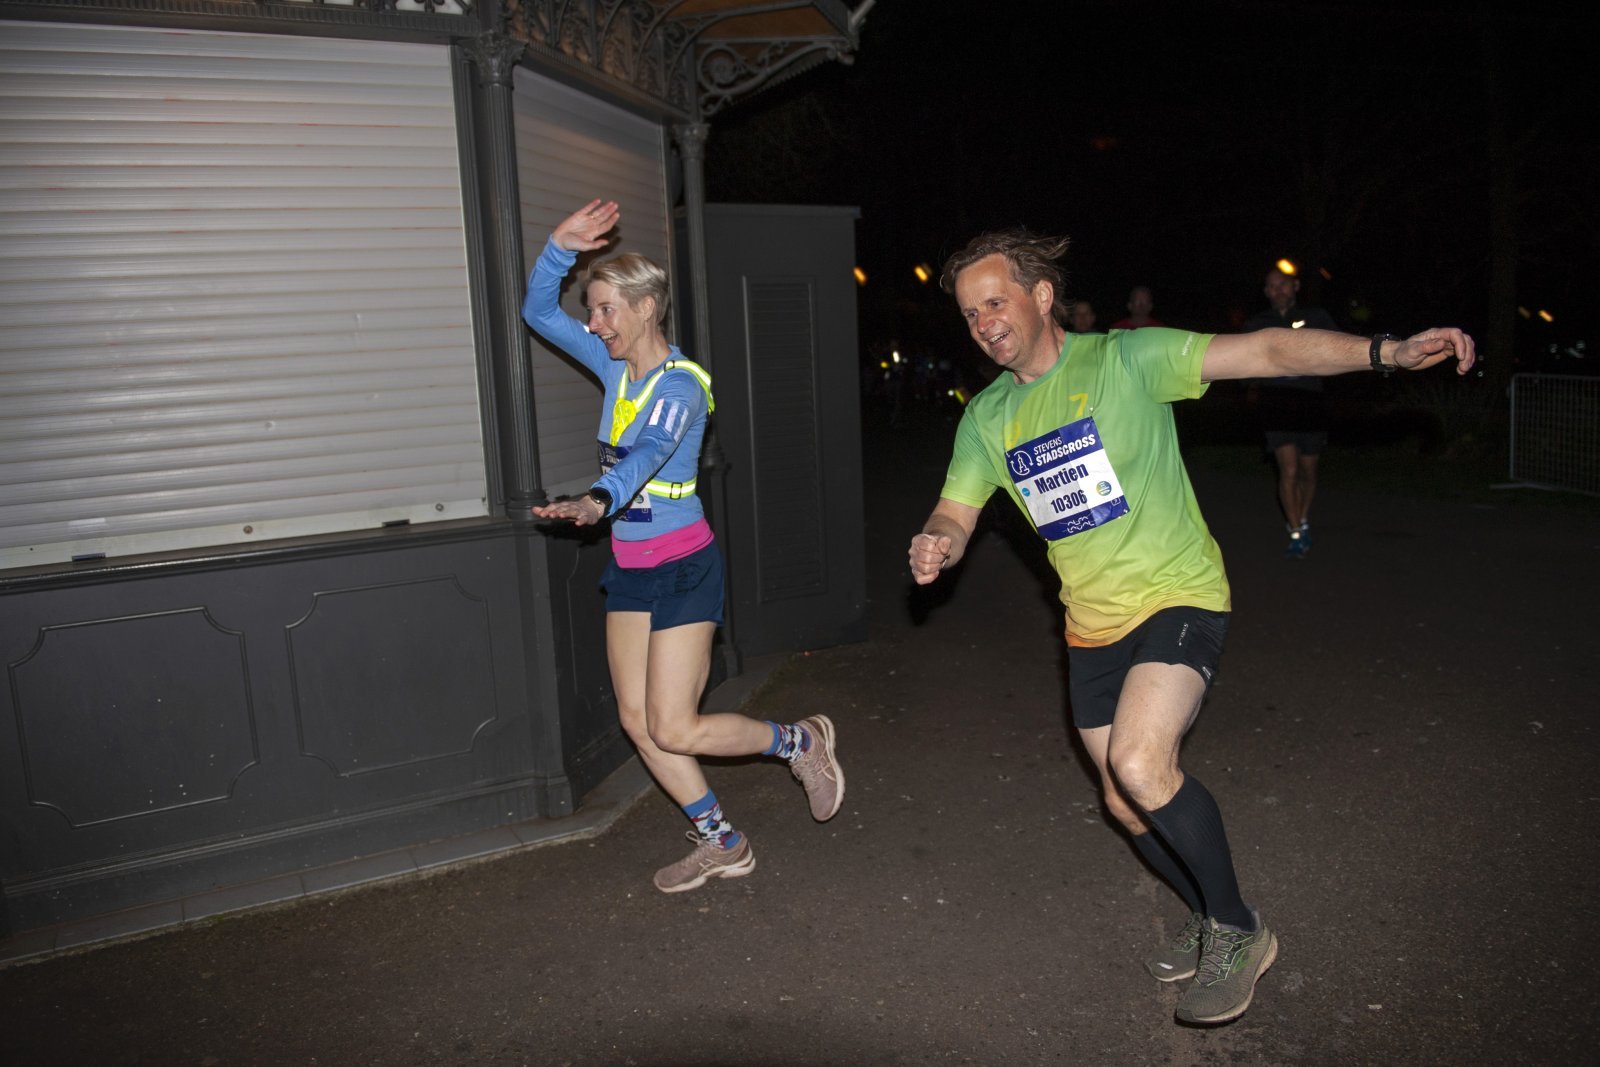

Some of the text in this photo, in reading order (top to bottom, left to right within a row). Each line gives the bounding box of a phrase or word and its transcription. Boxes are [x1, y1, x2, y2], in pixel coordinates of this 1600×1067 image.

[1034, 436, 1063, 456] STEVENS
[1036, 434, 1096, 466] STADSCROSS
[1034, 463, 1090, 495] Martien
[1051, 489, 1088, 514] 10306
